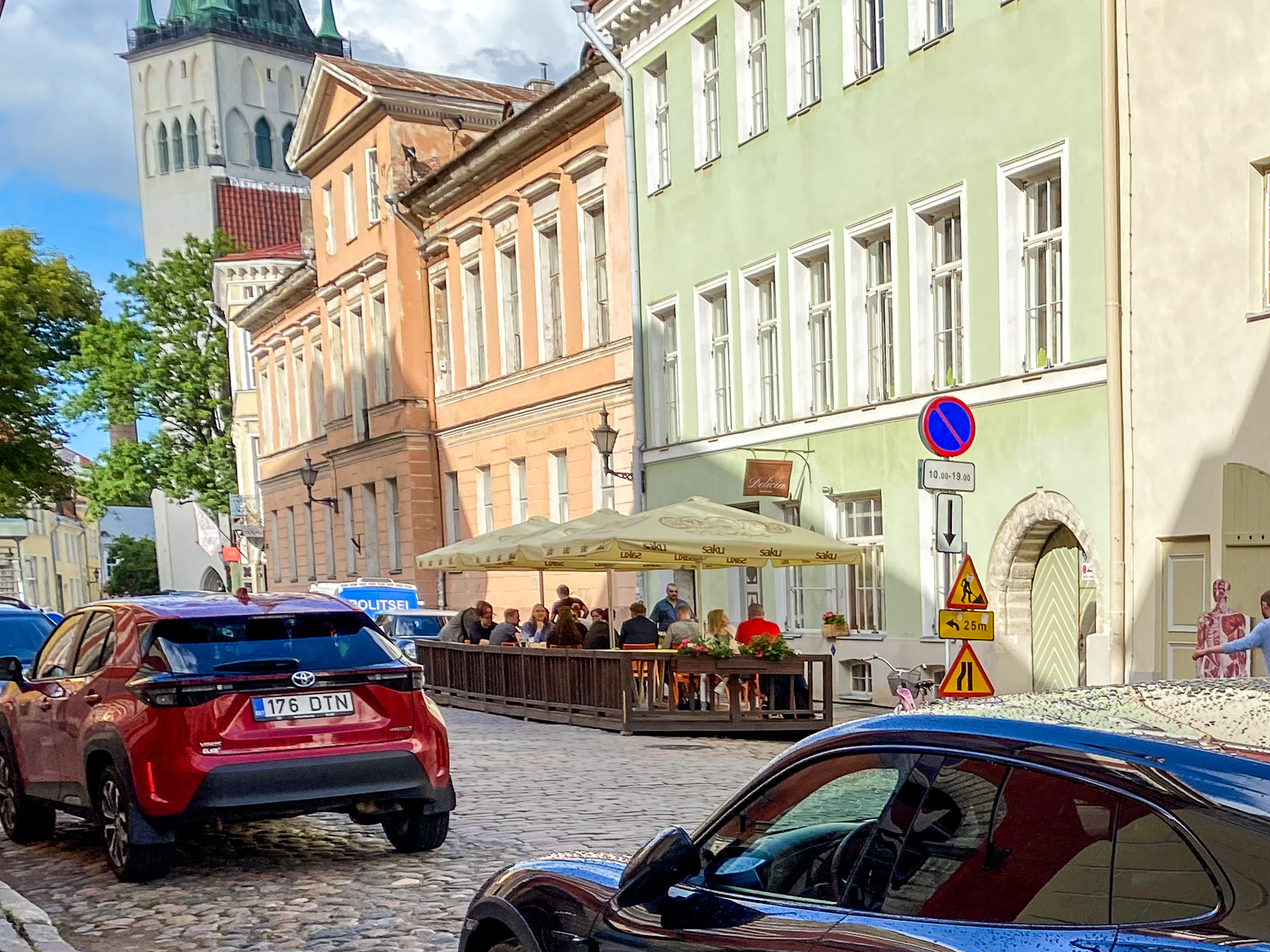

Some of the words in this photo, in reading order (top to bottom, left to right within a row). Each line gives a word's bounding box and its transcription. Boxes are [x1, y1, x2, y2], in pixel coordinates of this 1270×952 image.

[929, 470, 970, 481] 10.00-19.00
[747, 476, 786, 489] Delicia
[701, 544, 725, 555] saku
[759, 547, 782, 557] saku
[815, 551, 837, 560] saku
[268, 698, 299, 714] 176
[309, 694, 348, 711] DTN
